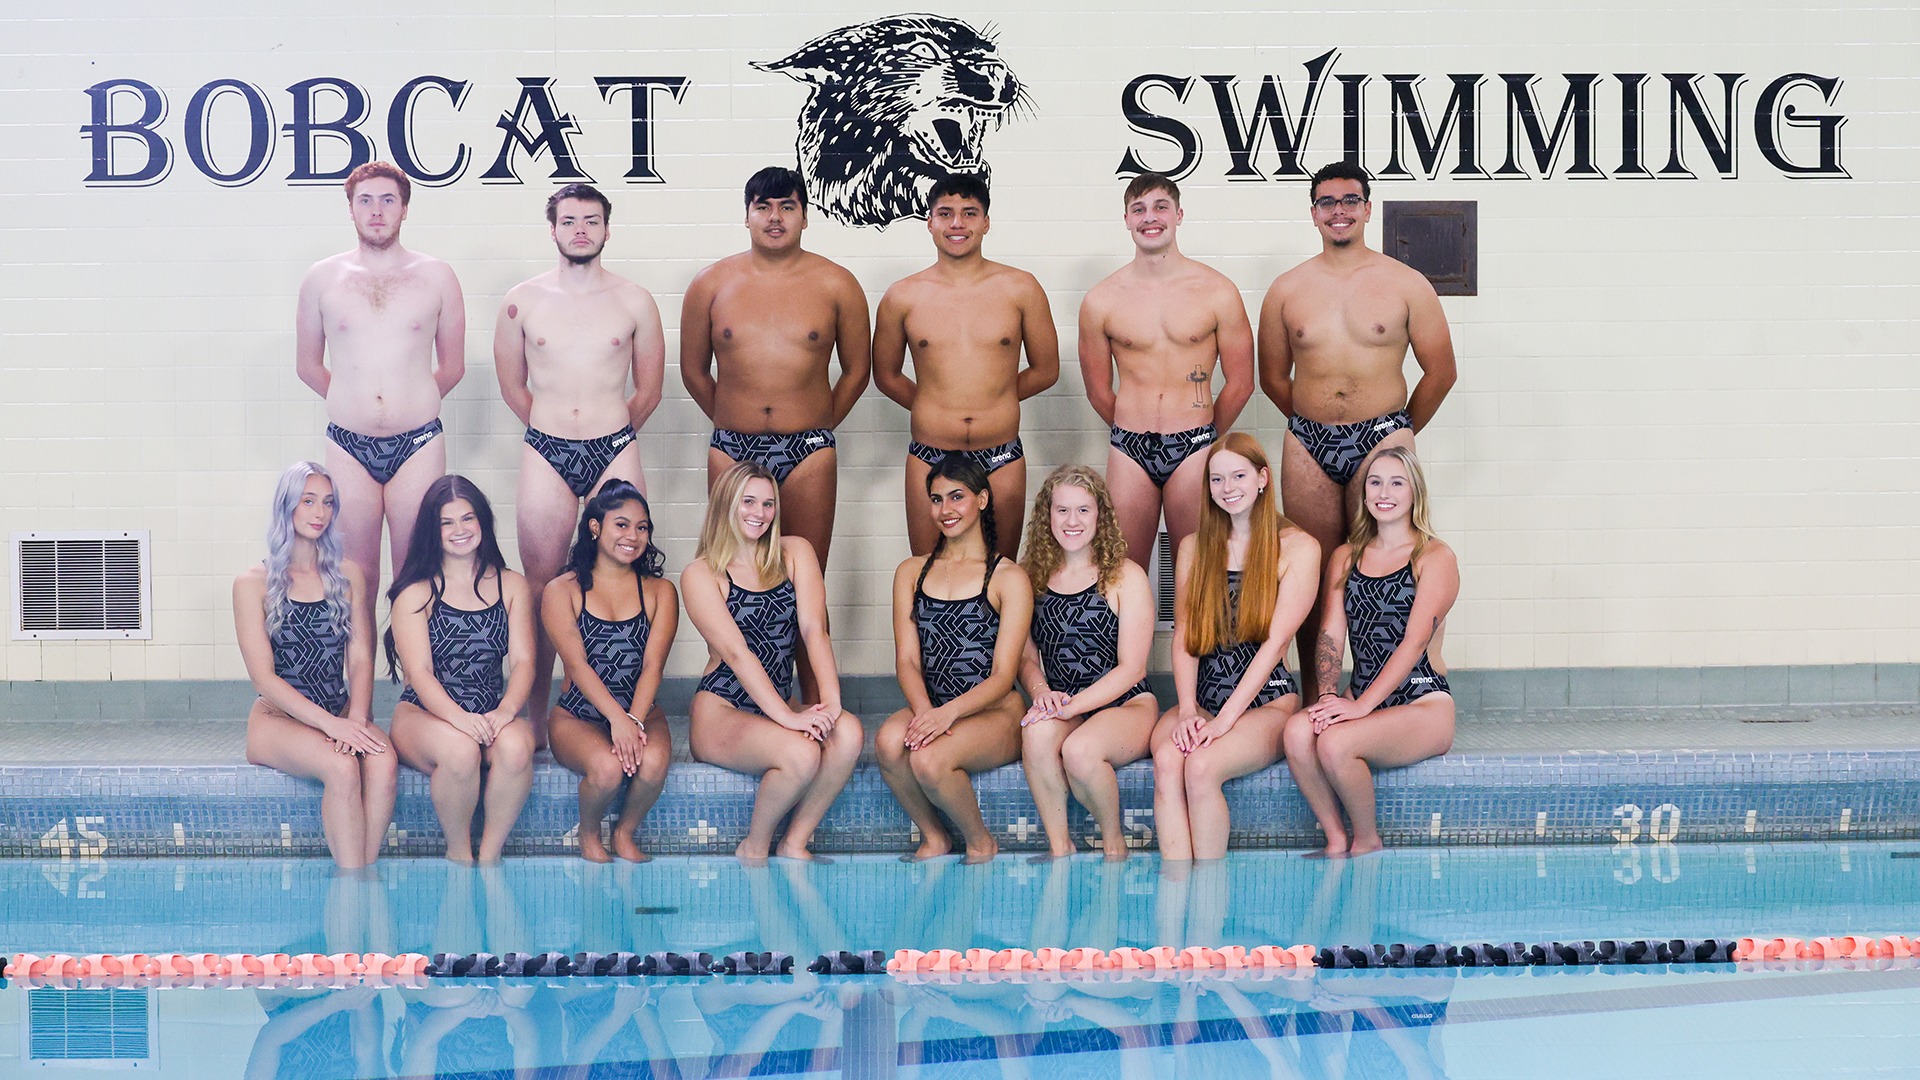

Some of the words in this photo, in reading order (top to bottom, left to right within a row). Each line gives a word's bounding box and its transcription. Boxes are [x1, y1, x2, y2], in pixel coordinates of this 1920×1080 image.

[79, 75, 692, 187] BOBCAT
[1114, 46, 1851, 181] SWIMMING
[1373, 419, 1395, 432] arena
[413, 431, 433, 445] arena
[612, 434, 631, 448] arena
[806, 435, 825, 445] arena
[1191, 432, 1210, 444] arena
[991, 452, 1011, 463] arena
[1268, 678, 1288, 687] arena
[1410, 676, 1433, 685] arena
[1611, 803, 1681, 842] 30
[40, 816, 108, 856] 45
